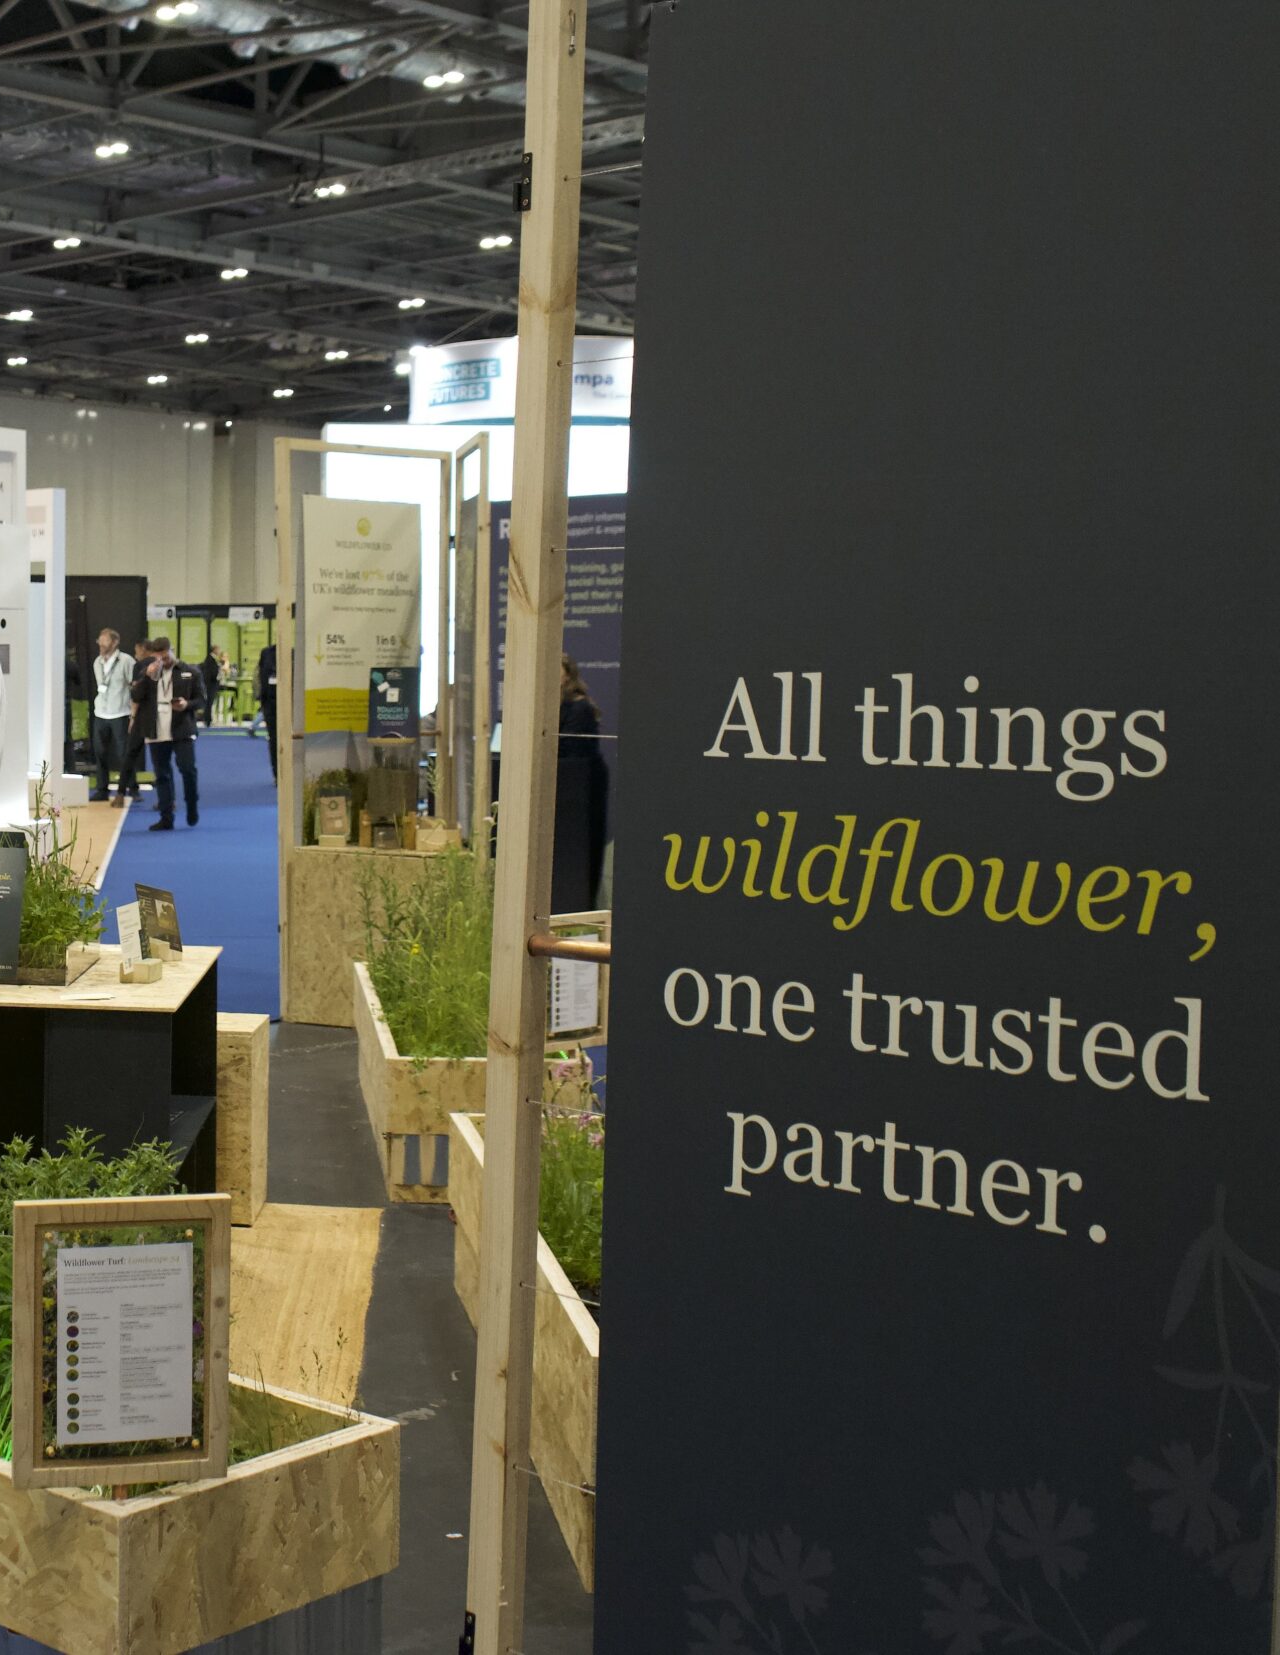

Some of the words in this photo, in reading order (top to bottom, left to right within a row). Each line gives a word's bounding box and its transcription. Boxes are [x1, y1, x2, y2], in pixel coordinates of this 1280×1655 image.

[574, 372, 614, 388] mpa
[334, 584, 376, 596] wildflower
[326, 634, 345, 645] 54%
[703, 671, 826, 762] All
[854, 673, 1167, 801] things
[662, 811, 1216, 962] wildflower,
[663, 965, 815, 1042] one
[843, 972, 1209, 1101] trusted
[724, 1111, 1106, 1243] partner.
[64, 1258, 105, 1267] Wildflower
